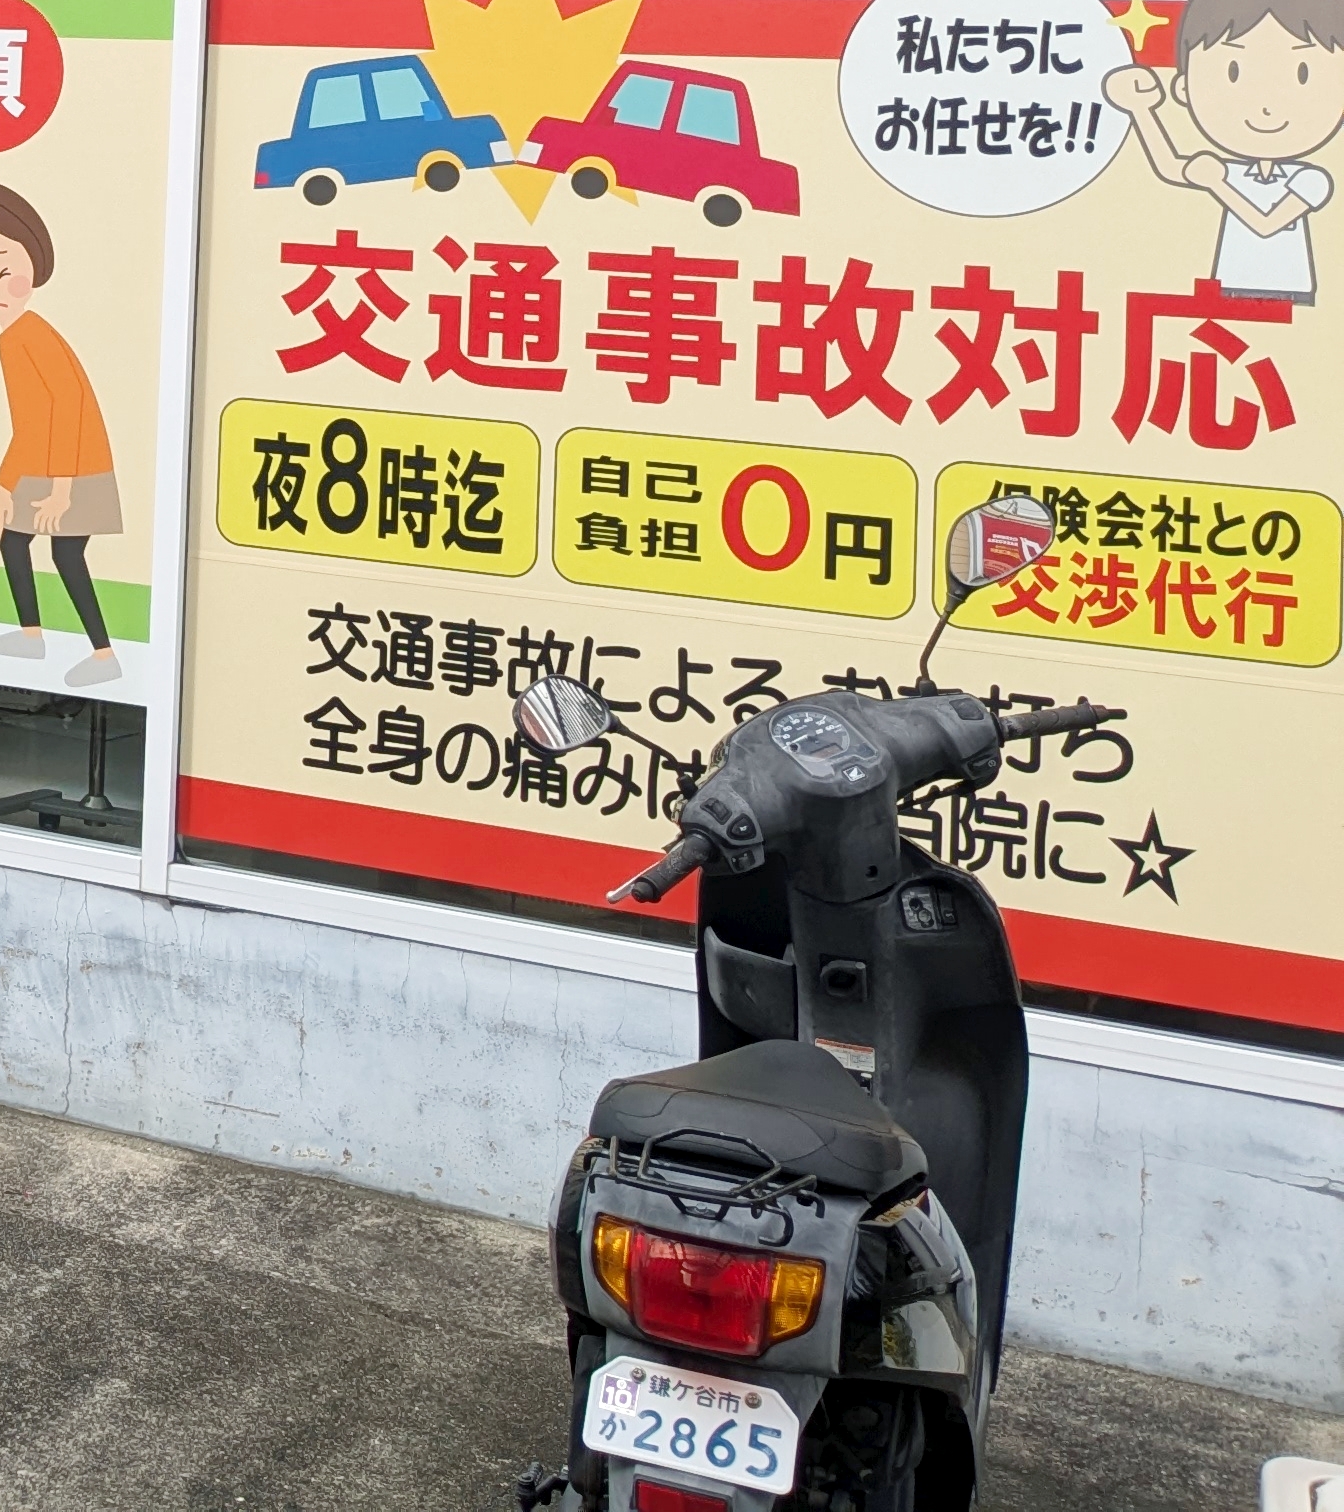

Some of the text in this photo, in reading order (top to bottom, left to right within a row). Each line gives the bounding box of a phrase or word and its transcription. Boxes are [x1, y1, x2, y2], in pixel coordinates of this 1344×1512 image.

[896, 14, 1084, 75] 私たちに
[875, 95, 1102, 158] お任せを!!
[275, 228, 1297, 452] 交通事故対応
[252, 418, 506, 556] 夜8時迄
[580, 454, 703, 504] 自己
[574, 512, 702, 563] 負担
[992, 550, 1299, 648] 交渉代行
[305, 601, 1134, 784] 交通事故による打ち
[599, 1409, 782, 1478] か 2865
